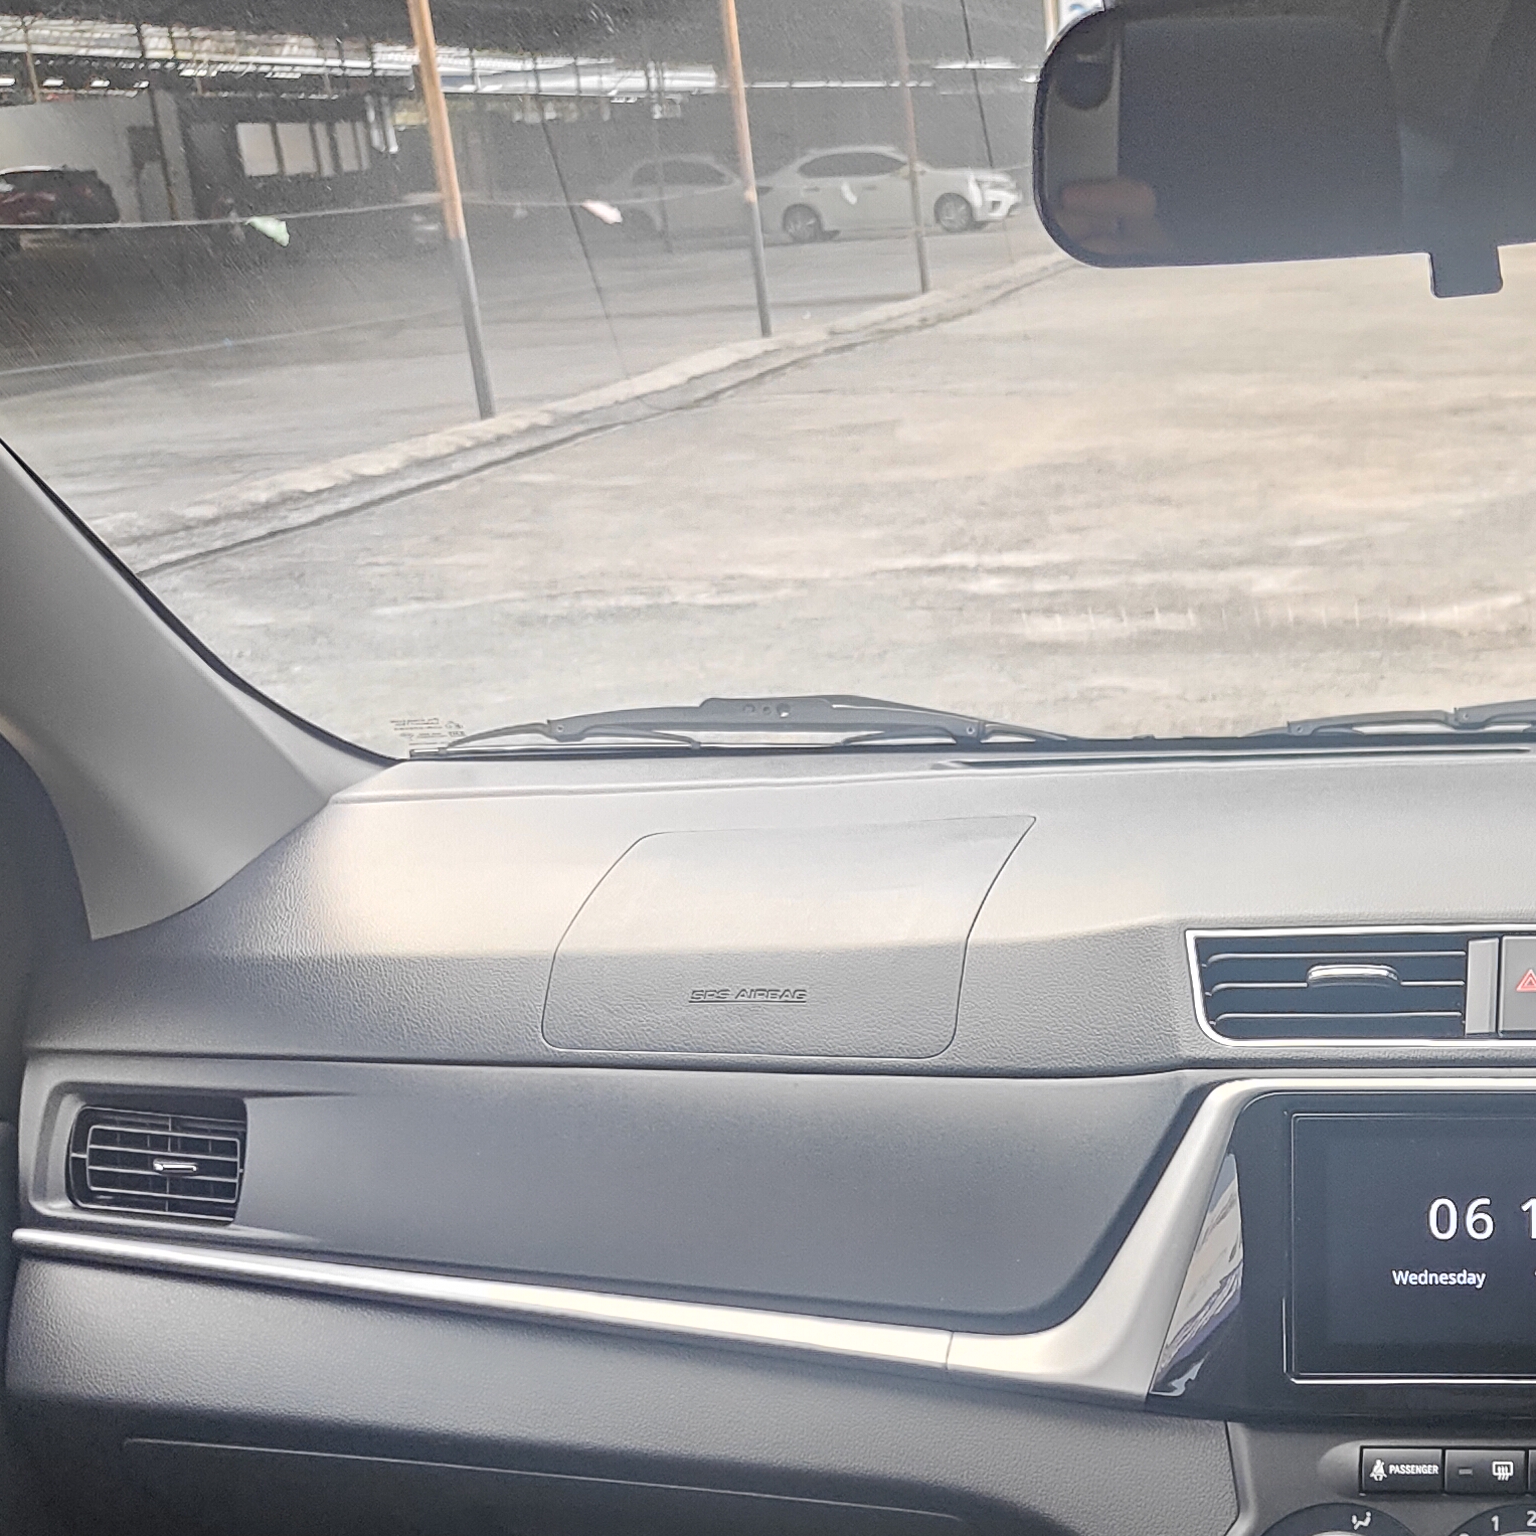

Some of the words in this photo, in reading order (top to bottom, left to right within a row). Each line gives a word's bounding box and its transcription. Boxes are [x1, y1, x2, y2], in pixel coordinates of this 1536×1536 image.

[734, 988, 807, 1000] AIRBAG
[1428, 1197, 1494, 1240] 06
[1391, 1268, 1487, 1289] Wednesday
[1388, 1463, 1439, 1476] PASSENGER
[1491, 1515, 1500, 1531] 1
